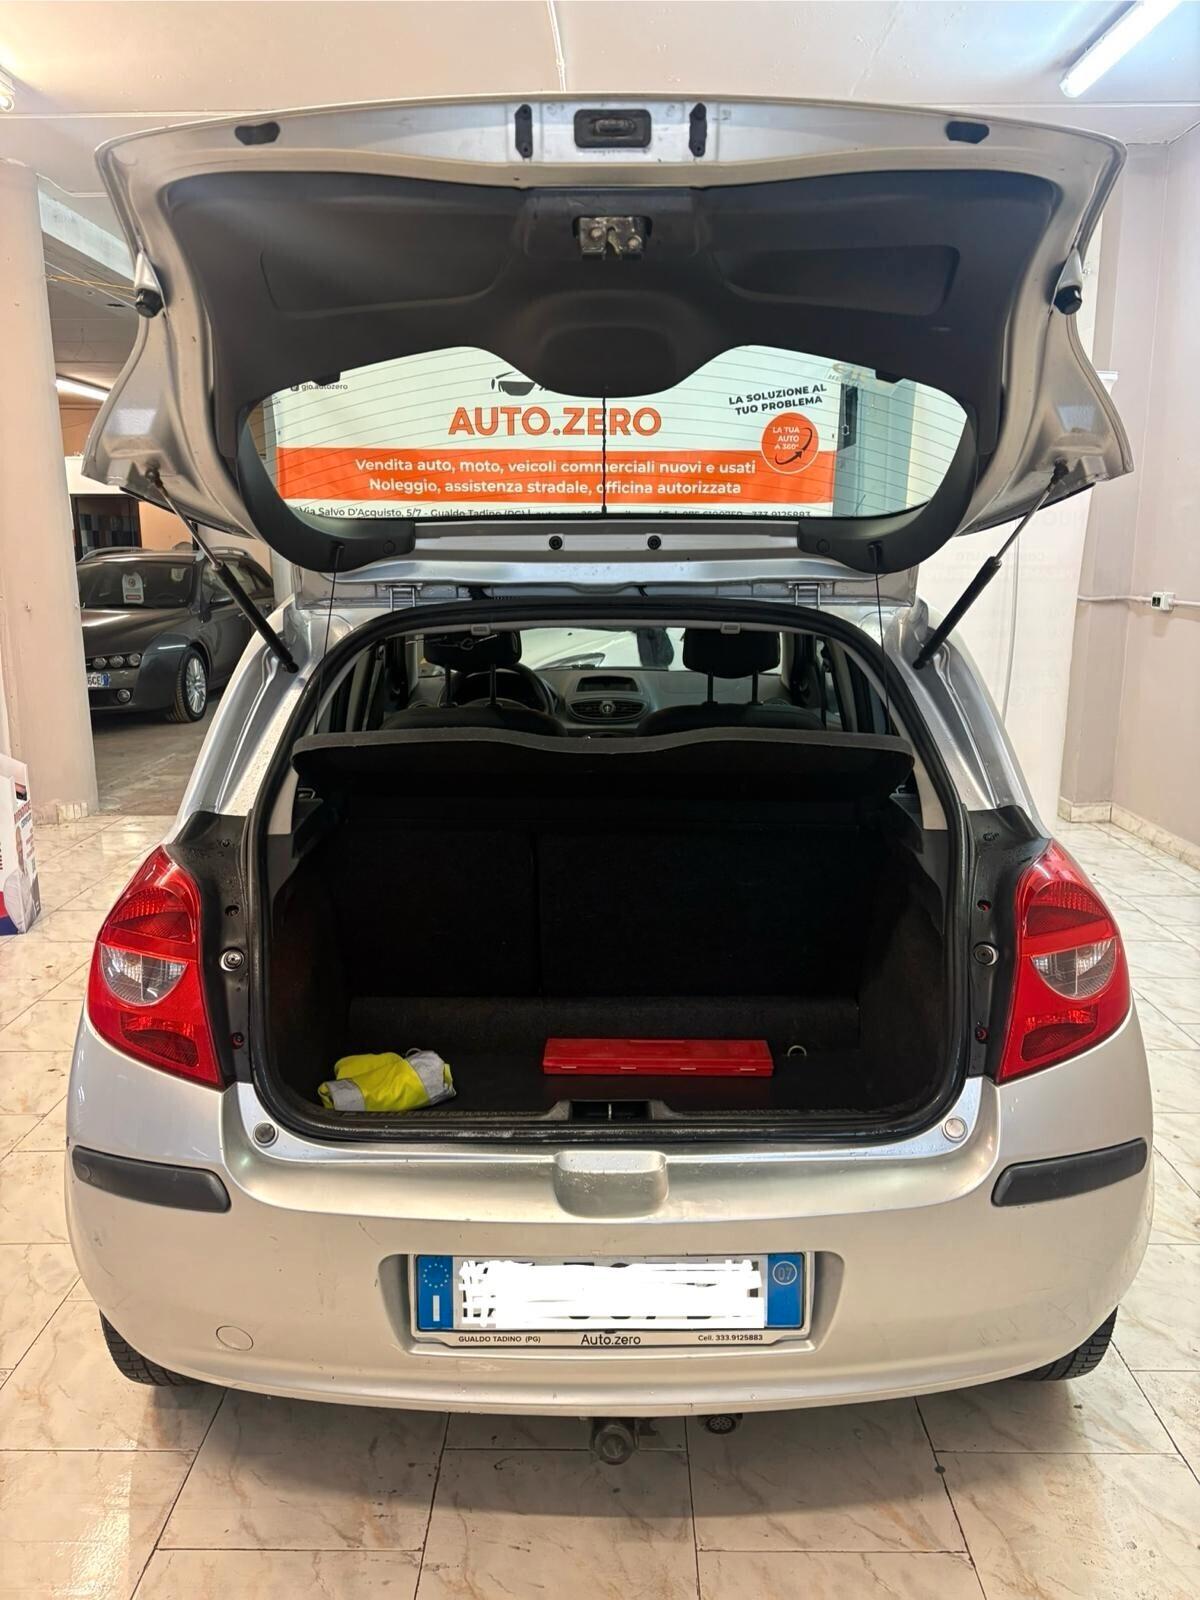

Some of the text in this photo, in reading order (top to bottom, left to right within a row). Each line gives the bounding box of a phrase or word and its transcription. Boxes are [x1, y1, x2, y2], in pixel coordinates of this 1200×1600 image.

[729, 384, 827, 405] LA SOLUZIONE AL
[735, 396, 823, 415] TUO PROBLEMA
[448, 406, 663, 437] AUTO.ZERO
[784, 426, 800, 434] TUA
[355, 459, 756, 474] Vendita auto, moto, veicoli commerciali nuovi e usati
[368, 478, 742, 496] Noleggio, assistenza stradale, officina autorizzata
[318, 507, 346, 517] Salvo
[347, 508, 404, 518] D'Acquisto,
[406, 508, 422, 518] 5/7
[430, 509, 465, 517] Gualdo
[778, 1266, 793, 1281] 07
[580, 1334, 641, 1345] Auto.zero
